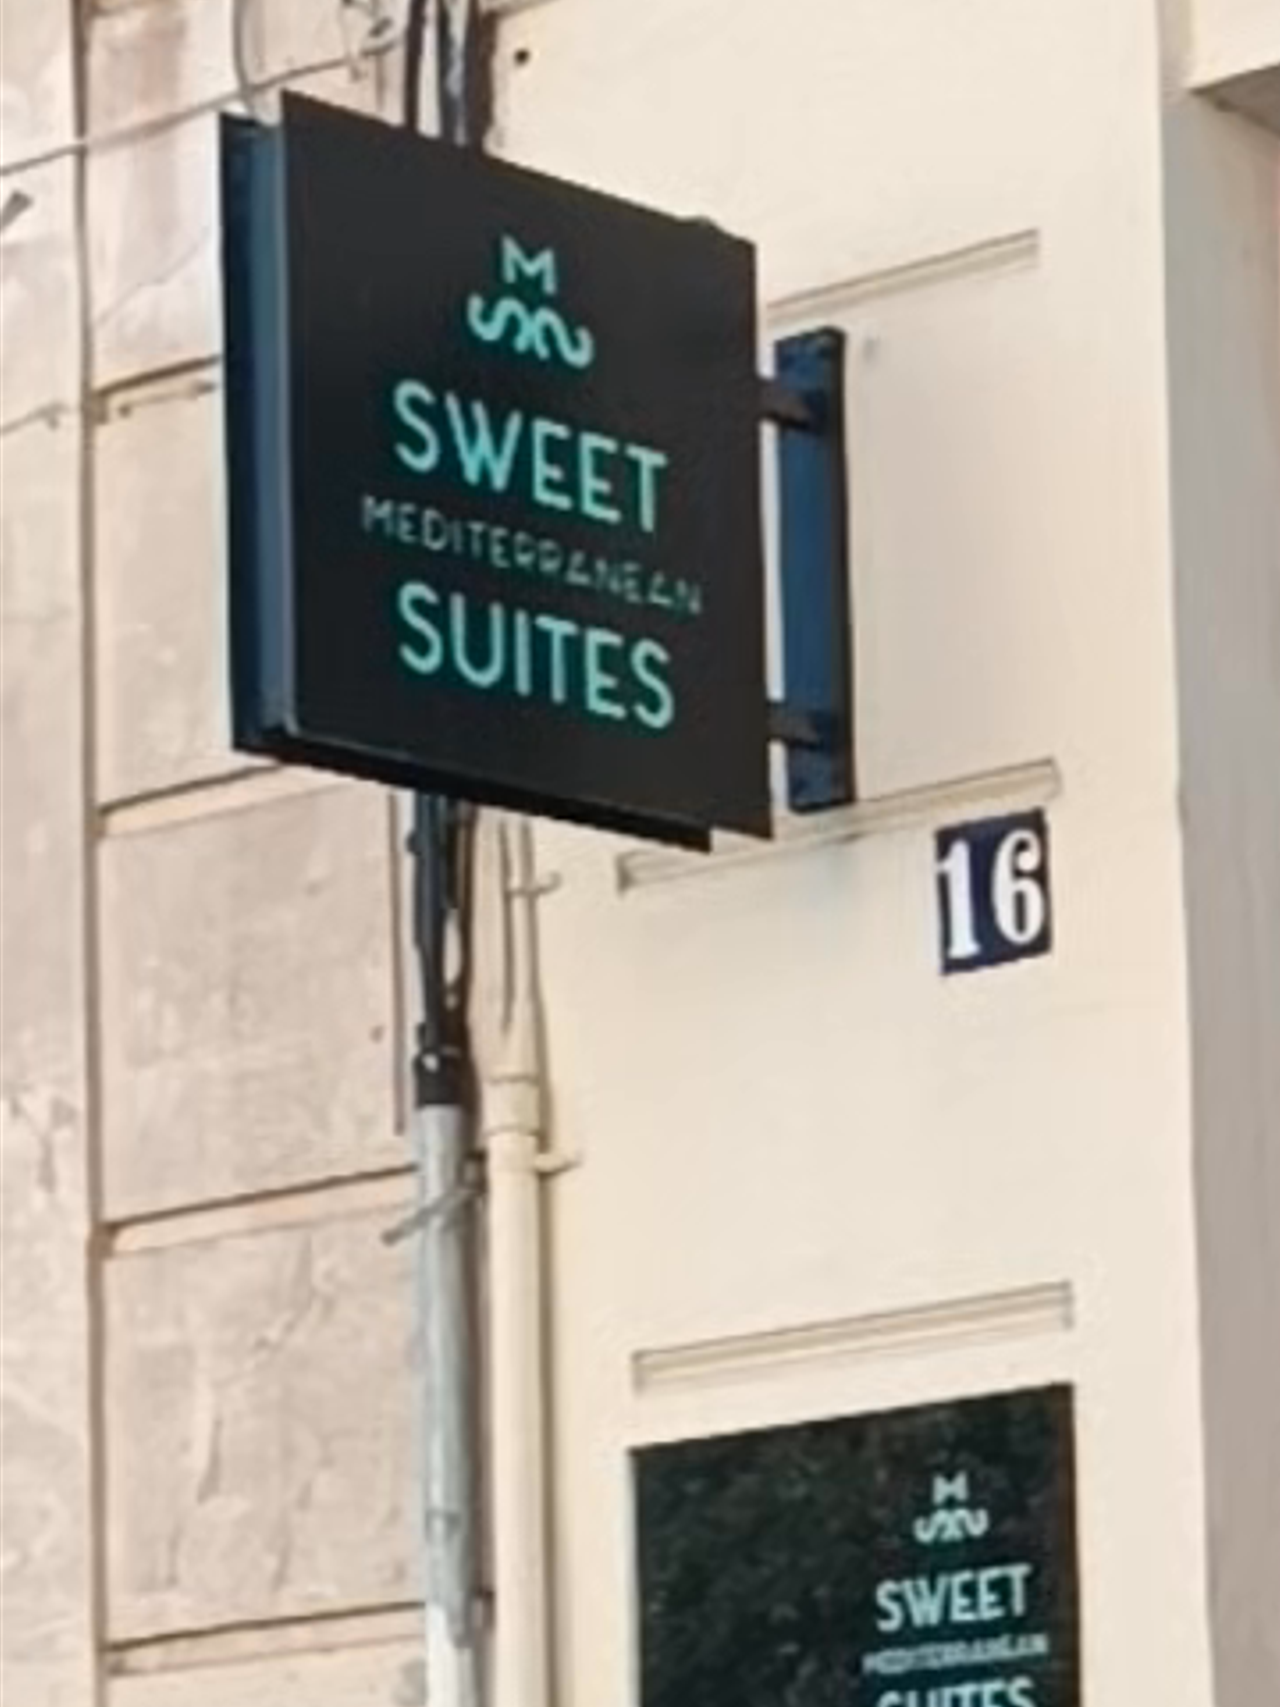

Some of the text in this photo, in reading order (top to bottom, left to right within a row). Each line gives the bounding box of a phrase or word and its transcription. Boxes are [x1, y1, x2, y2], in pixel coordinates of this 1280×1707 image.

[392, 379, 667, 533] SWEET
[398, 581, 675, 729] SUITES
[937, 828, 1045, 959] 16
[875, 1561, 1032, 1633] SWEET
